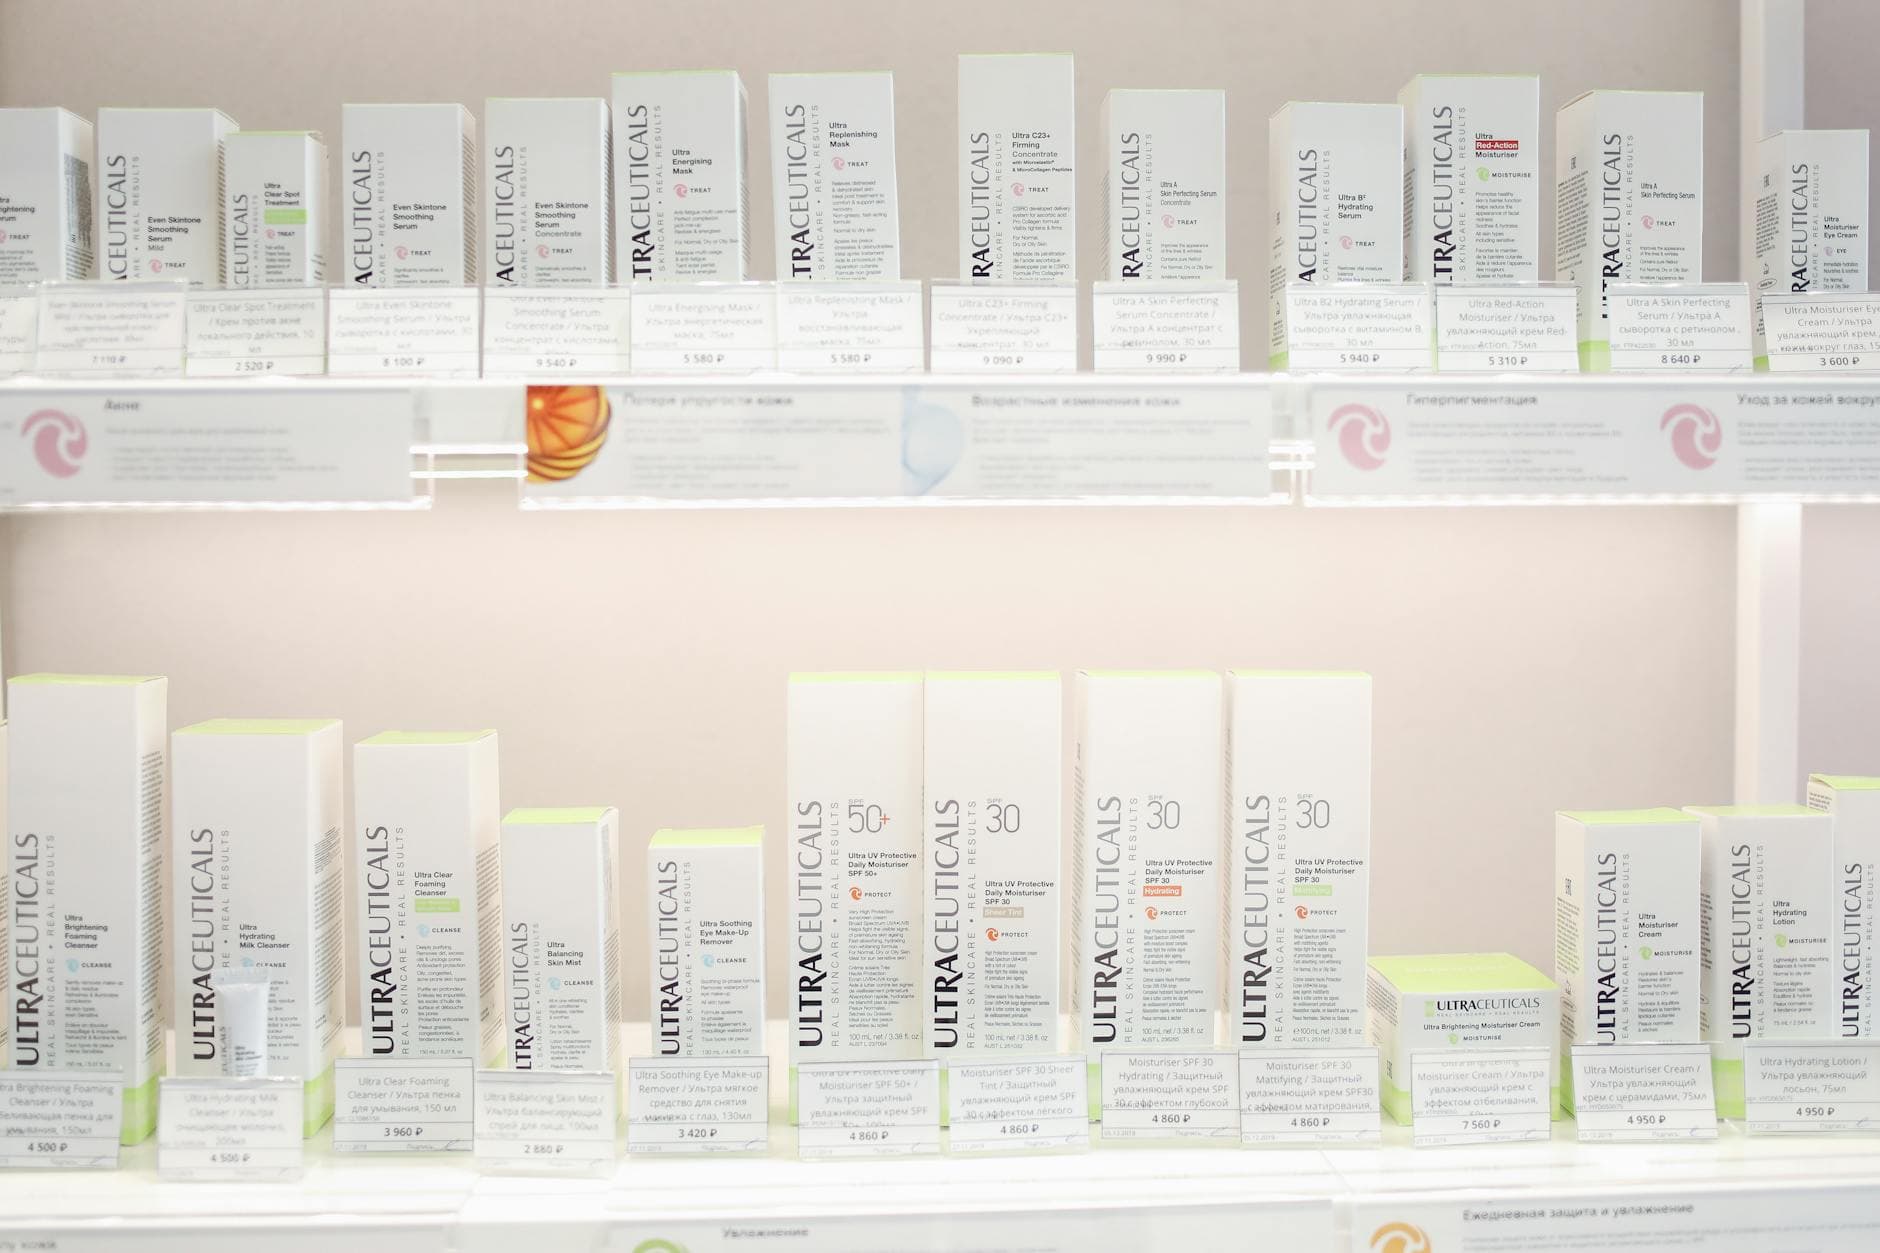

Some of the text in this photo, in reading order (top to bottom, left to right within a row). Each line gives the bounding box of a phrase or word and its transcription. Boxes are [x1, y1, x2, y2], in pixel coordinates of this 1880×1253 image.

[828, 121, 848, 130] Ultra
[830, 131, 877, 139] Replenishing
[1011, 131, 1051, 140] Ultra C23+
[1474, 132, 1494, 140] Ultra
[829, 139, 851, 148] Mask
[1012, 141, 1040, 149] Firming
[1475, 141, 1518, 150] Red-Action
[671, 148, 691, 157] Ultra
[1011, 150, 1058, 158] Concentrate
[1475, 151, 1519, 159] Moisturiser
[671, 158, 713, 167] Energising
[672, 167, 694, 175] Mask
[1159, 181, 1178, 189] Ultra A
[1640, 182, 1658, 190] Ultra A
[1159, 189, 1218, 199] Skin Perfecting Serum
[1337, 193, 1357, 202] Ultra
[1640, 191, 1695, 200] Skin Perfecting Serum
[392, 203, 447, 211] Even Skintone
[1338, 203, 1373, 211] Hydrating
[392, 213, 435, 222] Smoothing
[1337, 211, 1362, 220] Serum
[1823, 215, 1840, 224] Ultra
[392, 222, 419, 231] Serum
[1823, 223, 1860, 232] Moisturiser
[1824, 231, 1858, 240] Eye Cream
[1497, 356, 1517, 366] 310
[1671, 355, 1690, 364] 640
[848, 804, 890, 833] 50+
[986, 804, 1020, 833] 30
[1147, 800, 1180, 829] 30
[1296, 800, 1329, 828] 30
[848, 851, 917, 860] Ultra UV Protective
[849, 860, 909, 870] Daily Moisturiser
[1145, 859, 1213, 867] Ultra UV Protective
[1294, 858, 1364, 866] Ultra UV Protective
[414, 871, 454, 880] Ultra Clear
[847, 869, 878, 877] SPF 50+
[1145, 867, 1206, 877] Daily Moisturiser
[1295, 867, 1356, 876] Daily Moisturiser
[415, 880, 445, 889] Foaming
[984, 880, 1055, 889] Ultra UV Protective
[1144, 876, 1161, 885] SPF
[1294, 876, 1320, 884] SPF 30
[414, 888, 447, 897] Cleanser
[984, 888, 1046, 898] Daily Moisturiser
[1145, 887, 1179, 895] Hydrating
[984, 897, 1011, 906] SPF 30
[1772, 900, 1791, 908] Ultra
[1638, 913, 1656, 921] Ultra
[1773, 909, 1807, 917] Hydrating
[64, 914, 84, 923] Ultra
[1093, 797, 1122, 1042] ULTRACEUTICALS
[1242, 796, 1273, 1041] ULTRACEUTICALS
[1773, 917, 1795, 925] Lotion
[64, 923, 108, 932] Brightening
[239, 923, 258, 931] Ultra
[699, 920, 752, 929] Ultra Soothing
[798, 801, 827, 1047] ULTRACEUTICALS
[934, 801, 963, 1049] ULTRACEUTICALS
[1638, 921, 1679, 929] Moisturiser
[64, 933, 97, 941] Foaming
[239, 933, 275, 941] Hydrating
[700, 928, 750, 937] Eye Make-Up
[1638, 930, 1663, 938] Cream
[191, 829, 215, 1060] ULTRACEUTICALS
[366, 826, 396, 1054] ULTRACEUTICALS
[699, 938, 734, 946] Remover
[1732, 845, 1754, 1038] ULTRACEUTICALS
[1788, 937, 1827, 945] MOISTURISE
[15, 833, 43, 1065] ULTRACEUTICALS
[64, 941, 99, 950] Cleanser
[239, 941, 291, 949] Milk Cleanser
[546, 941, 566, 949] Ultra
[546, 950, 584, 959] Balancing
[1653, 949, 1693, 957] MOISTURISE
[658, 861, 683, 1055] ULTRACEUTICALS
[547, 959, 564, 967] Skin
[1437, 998, 1540, 1011] ULTRACEUTICALS
[1423, 1020, 1541, 1032] Ultra Brightening Moisturiser Cream
[1462, 1034, 1502, 1042] MOISTURISE
[1300, 1118, 1319, 1127] 860
[1636, 1115, 1655, 1124] 950
[393, 1127, 412, 1136] 960
